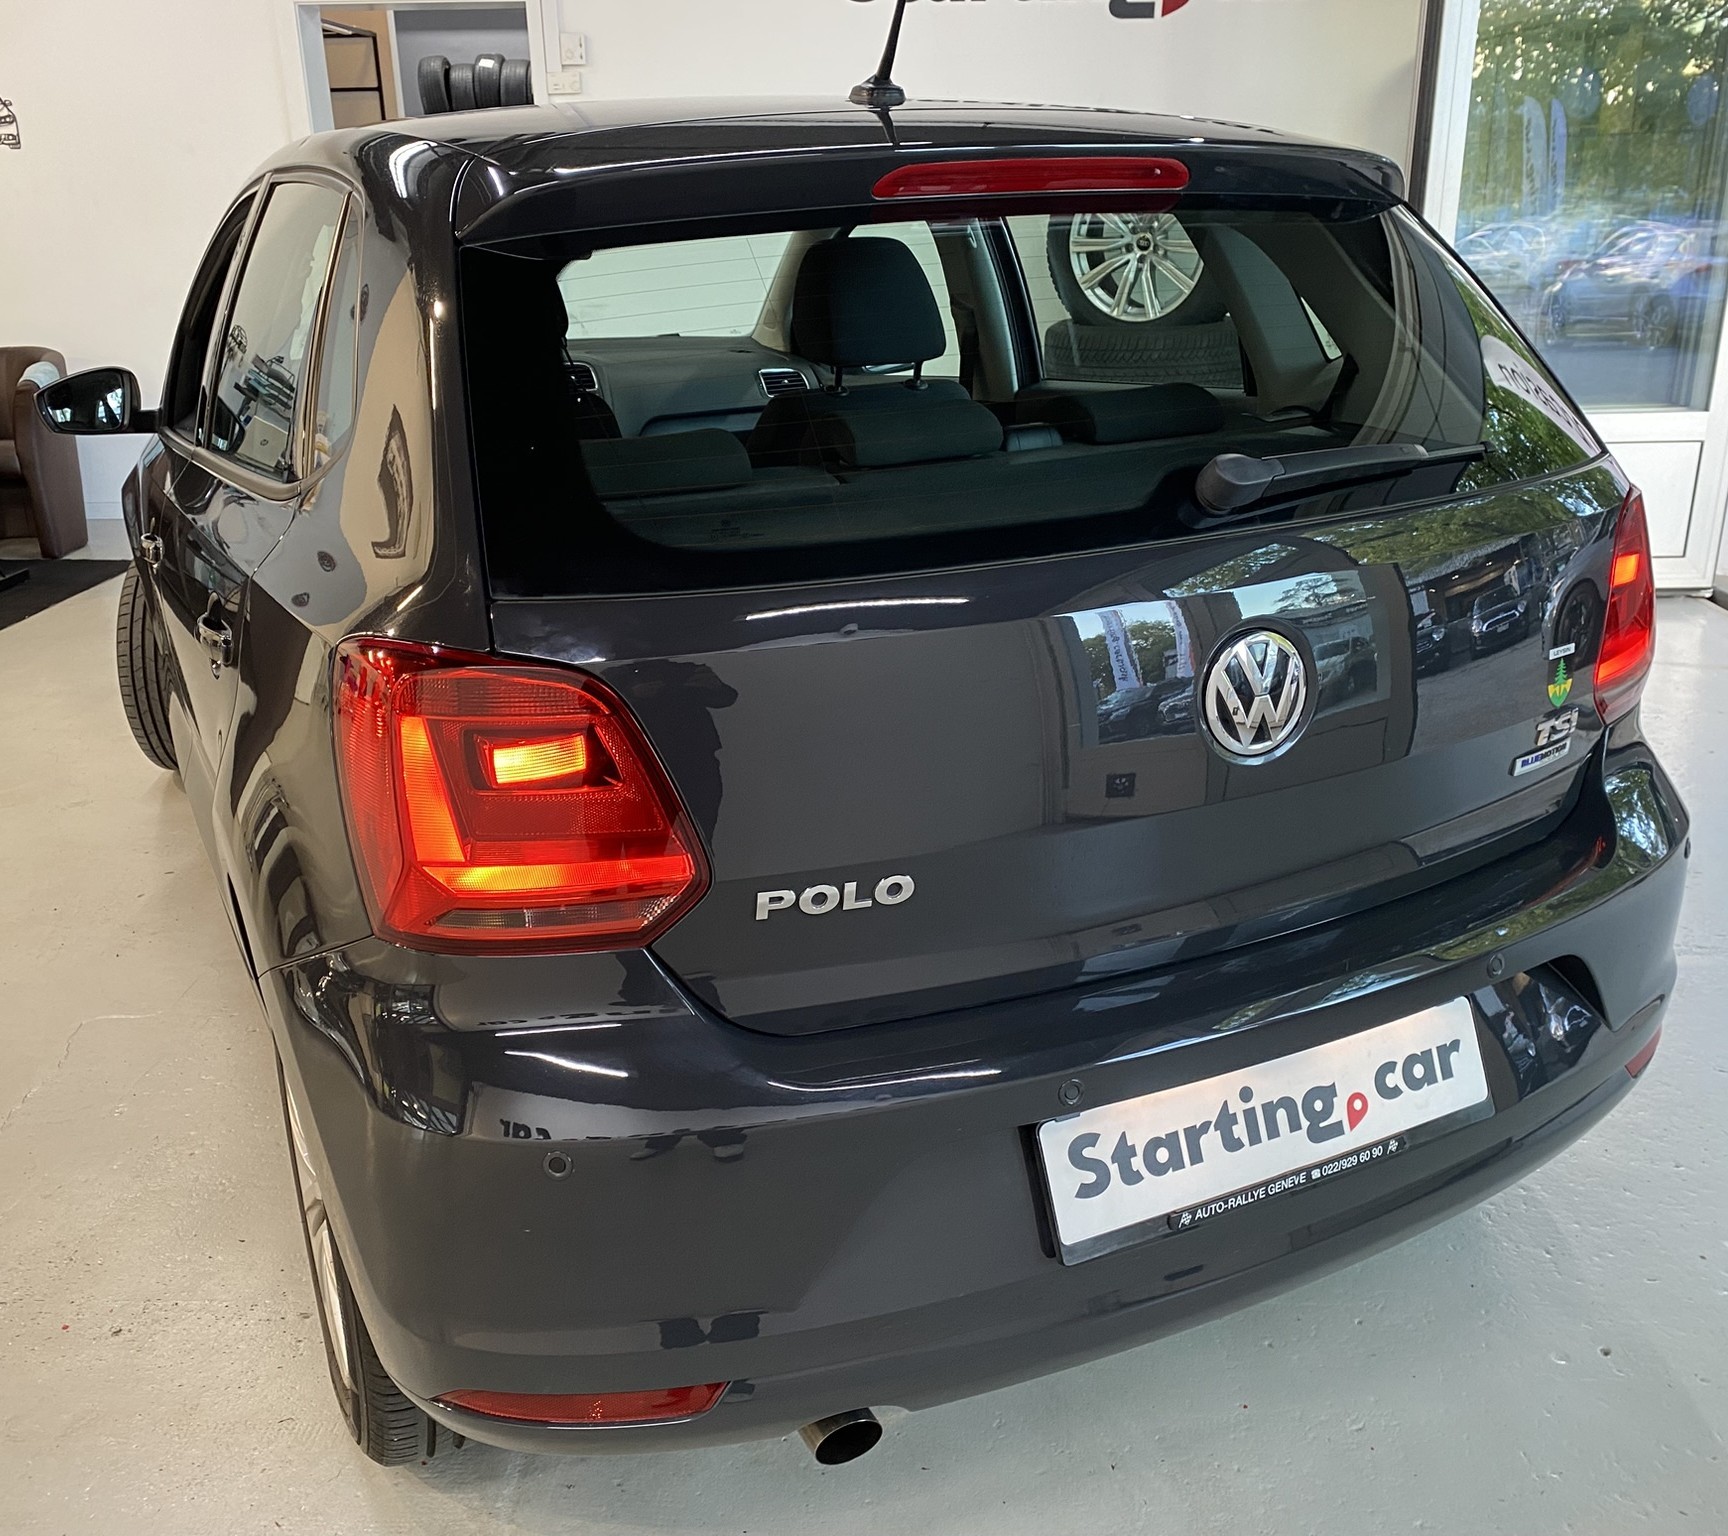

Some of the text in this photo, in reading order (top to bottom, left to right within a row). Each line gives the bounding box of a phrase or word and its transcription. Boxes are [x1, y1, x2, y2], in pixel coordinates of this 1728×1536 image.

[1537, 707, 1579, 746] TSI
[755, 874, 915, 921] POLO
[1067, 1038, 1461, 1199] Starting car
[1195, 1145, 1384, 1221] AUTO-RALLYE GENEVE 022/929 60 90
